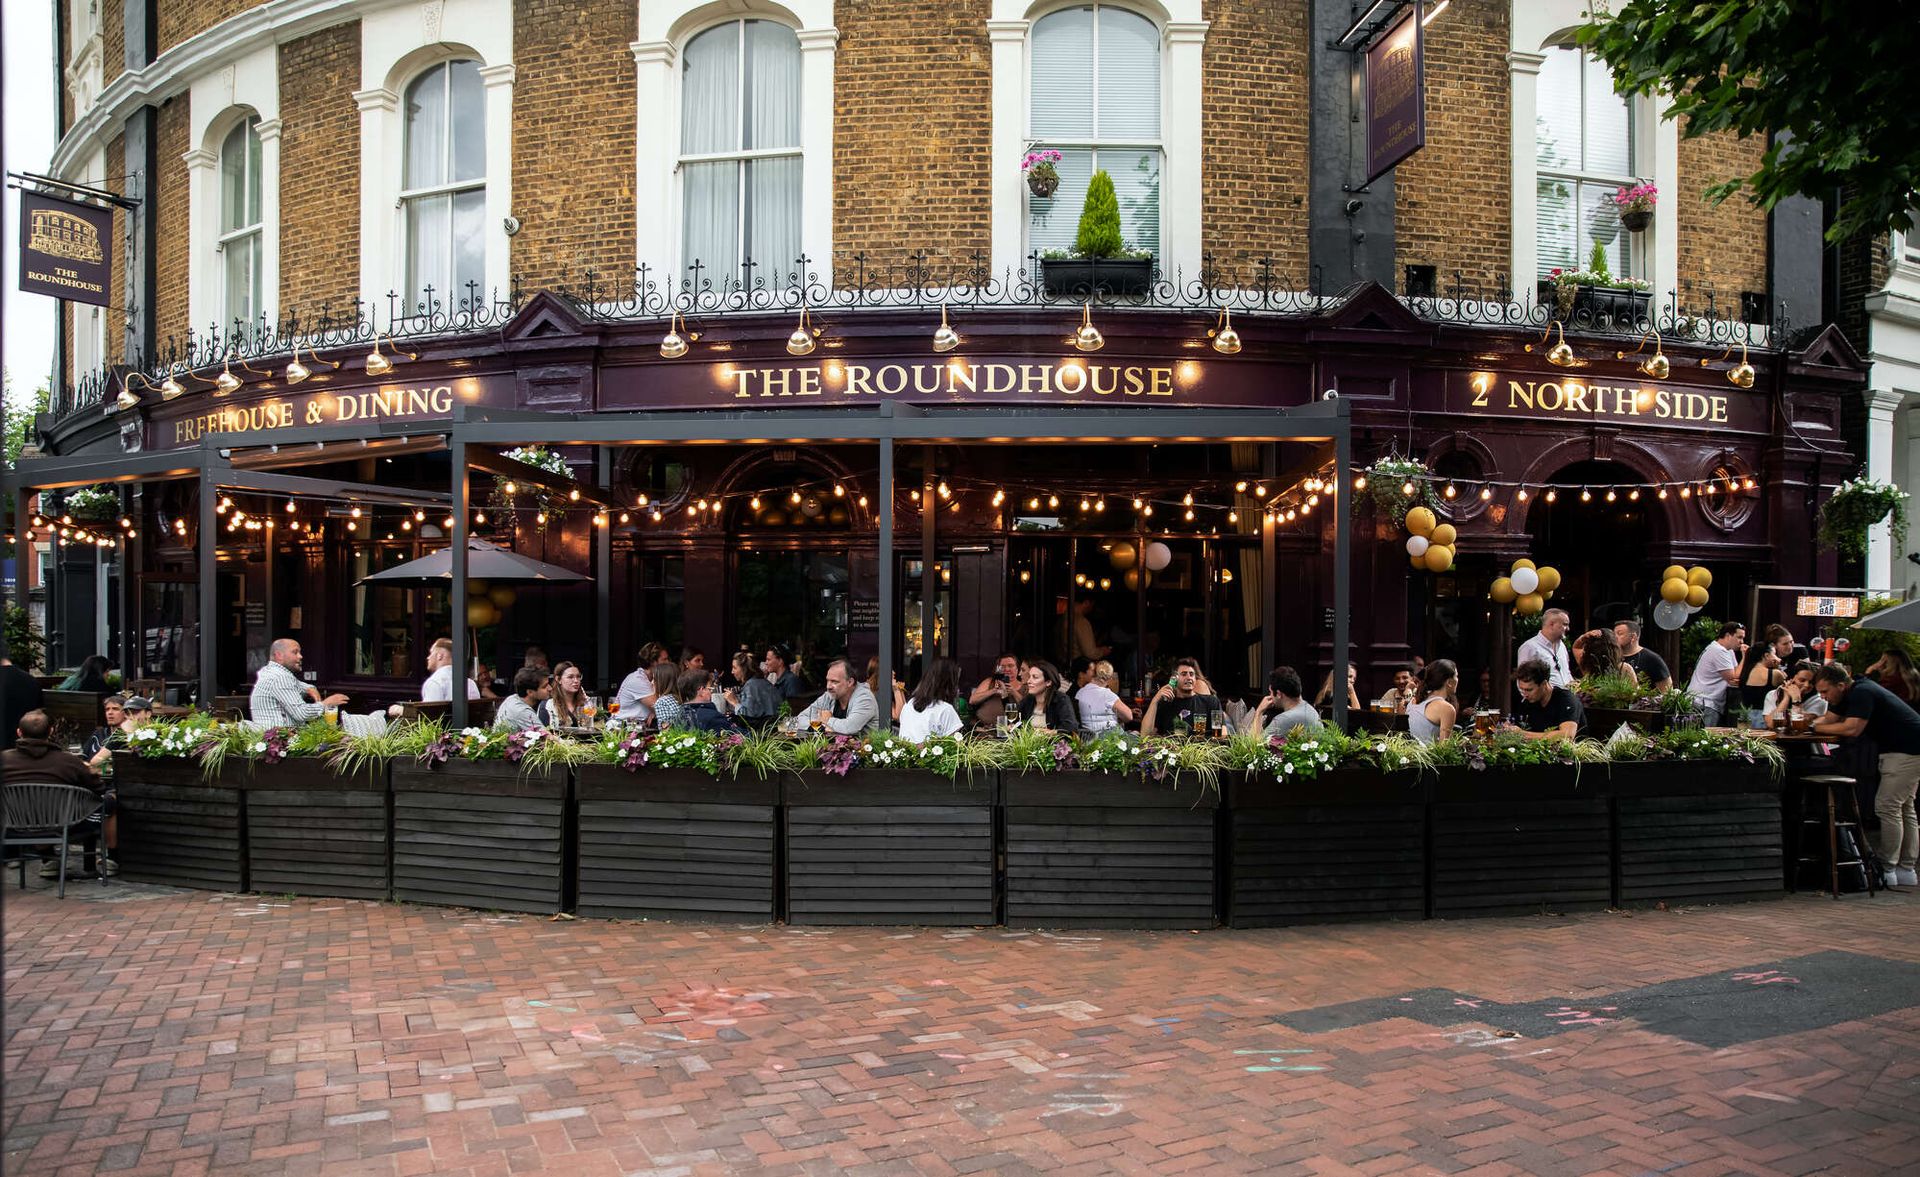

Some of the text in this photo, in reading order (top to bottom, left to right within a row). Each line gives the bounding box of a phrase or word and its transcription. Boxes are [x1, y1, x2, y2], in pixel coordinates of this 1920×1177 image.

[27, 271, 103, 293] ROUNDHOUSE
[54, 267, 78, 279] THE
[731, 364, 1174, 398] THE ROUNDHOUSE
[1471, 376, 1728, 423] 2 NORTH SIDE
[175, 386, 454, 443] FREEHOUSE & DINING
[1819, 604, 1834, 615] BAR
